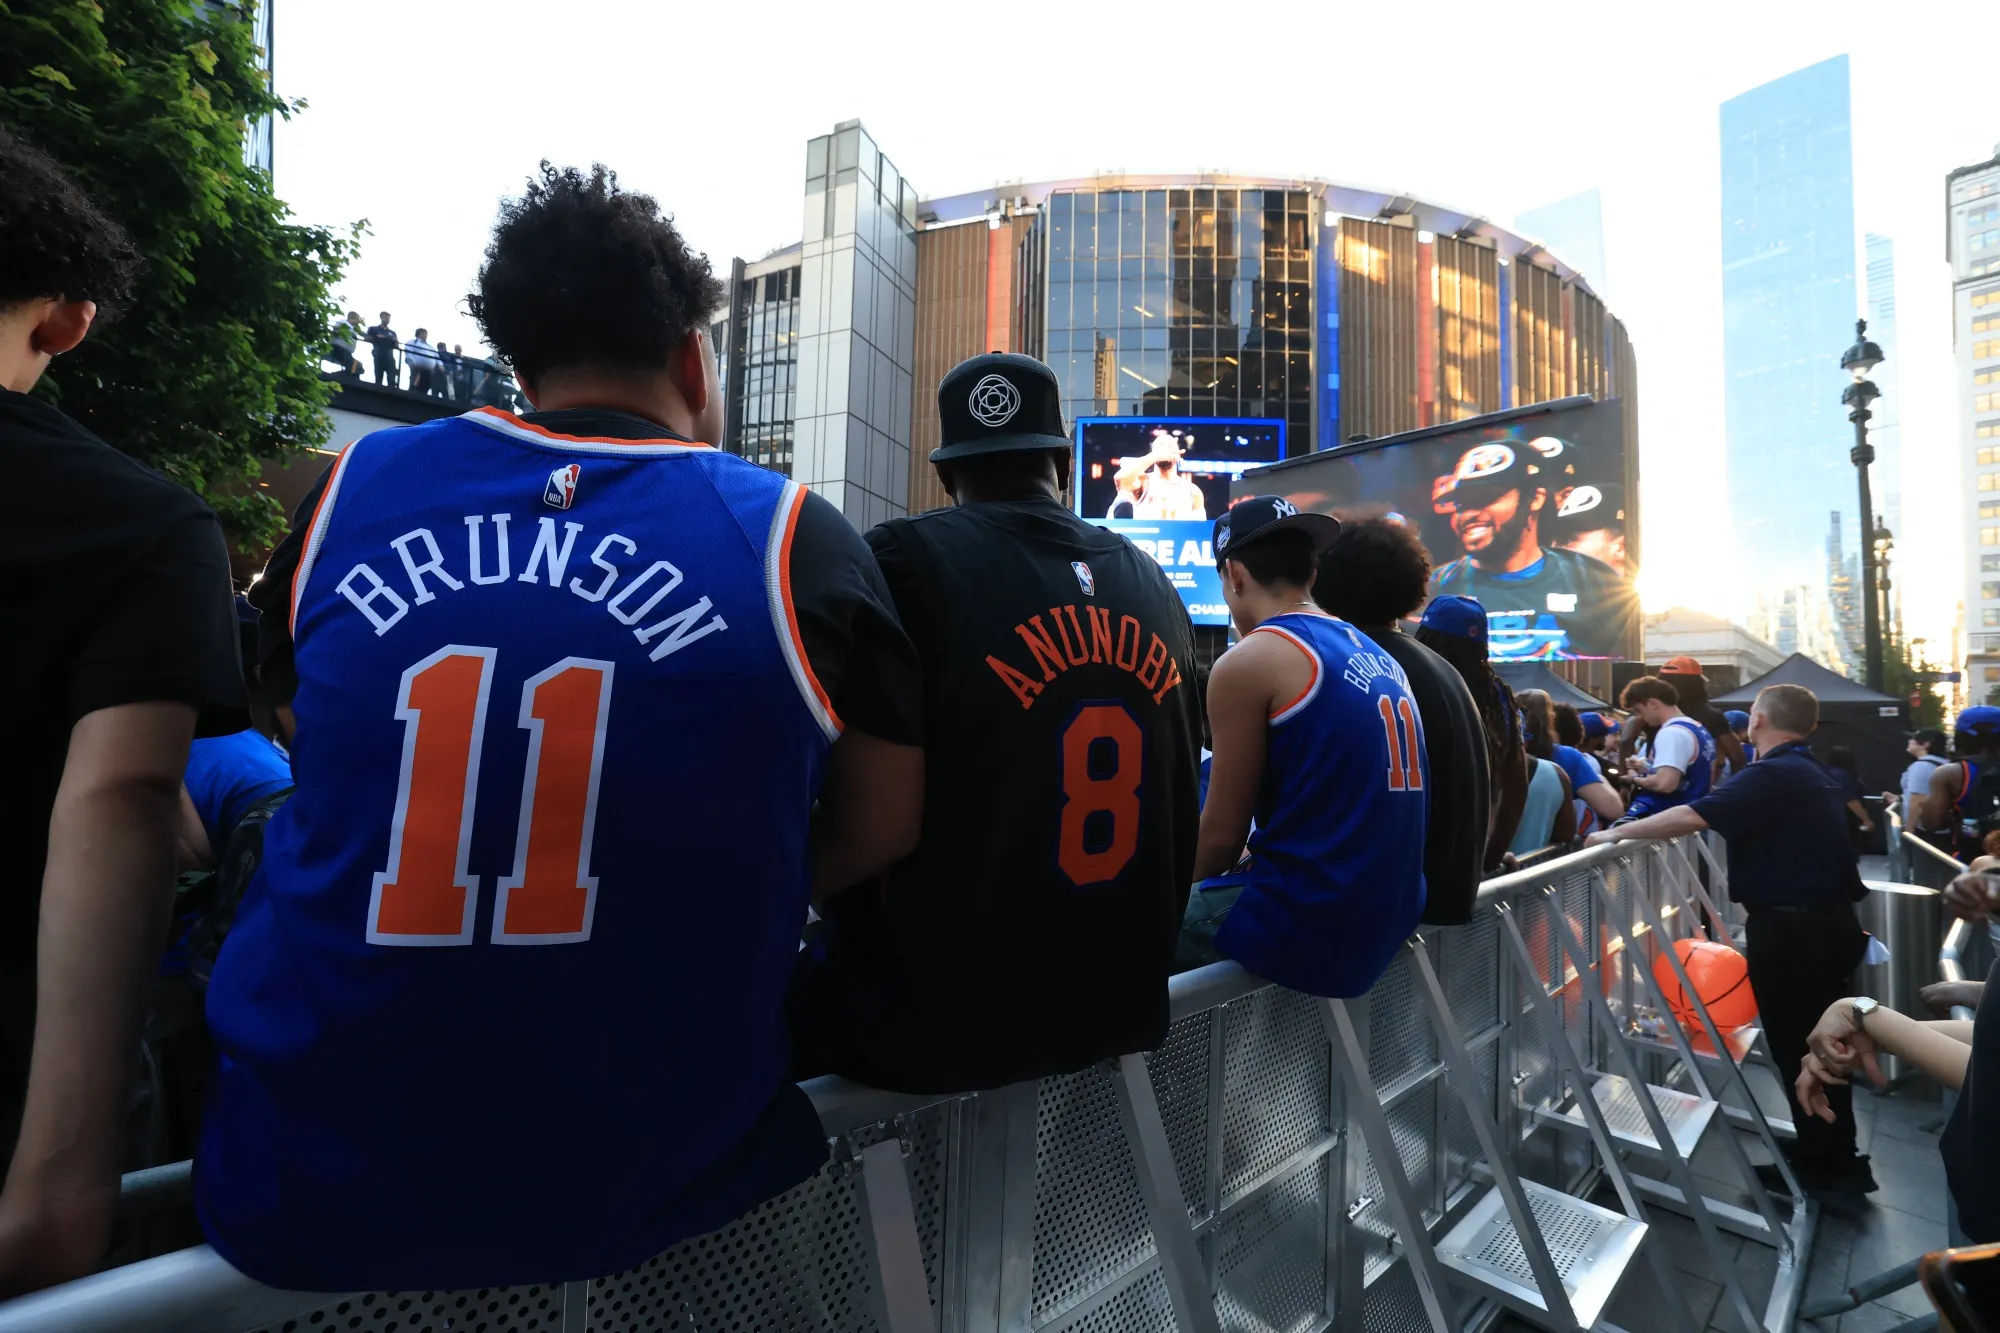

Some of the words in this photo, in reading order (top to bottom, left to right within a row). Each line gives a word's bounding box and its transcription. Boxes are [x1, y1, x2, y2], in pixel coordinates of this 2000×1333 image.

[547, 492, 561, 504] NBA
[1272, 499, 1297, 519] NY
[335, 513, 729, 662] BRUNSON
[1131, 540, 1175, 566] RE
[985, 604, 1183, 709] ANUNOBY
[1056, 699, 1145, 886] 8
[1377, 694, 1423, 791] 11
[365, 643, 615, 946] 11
